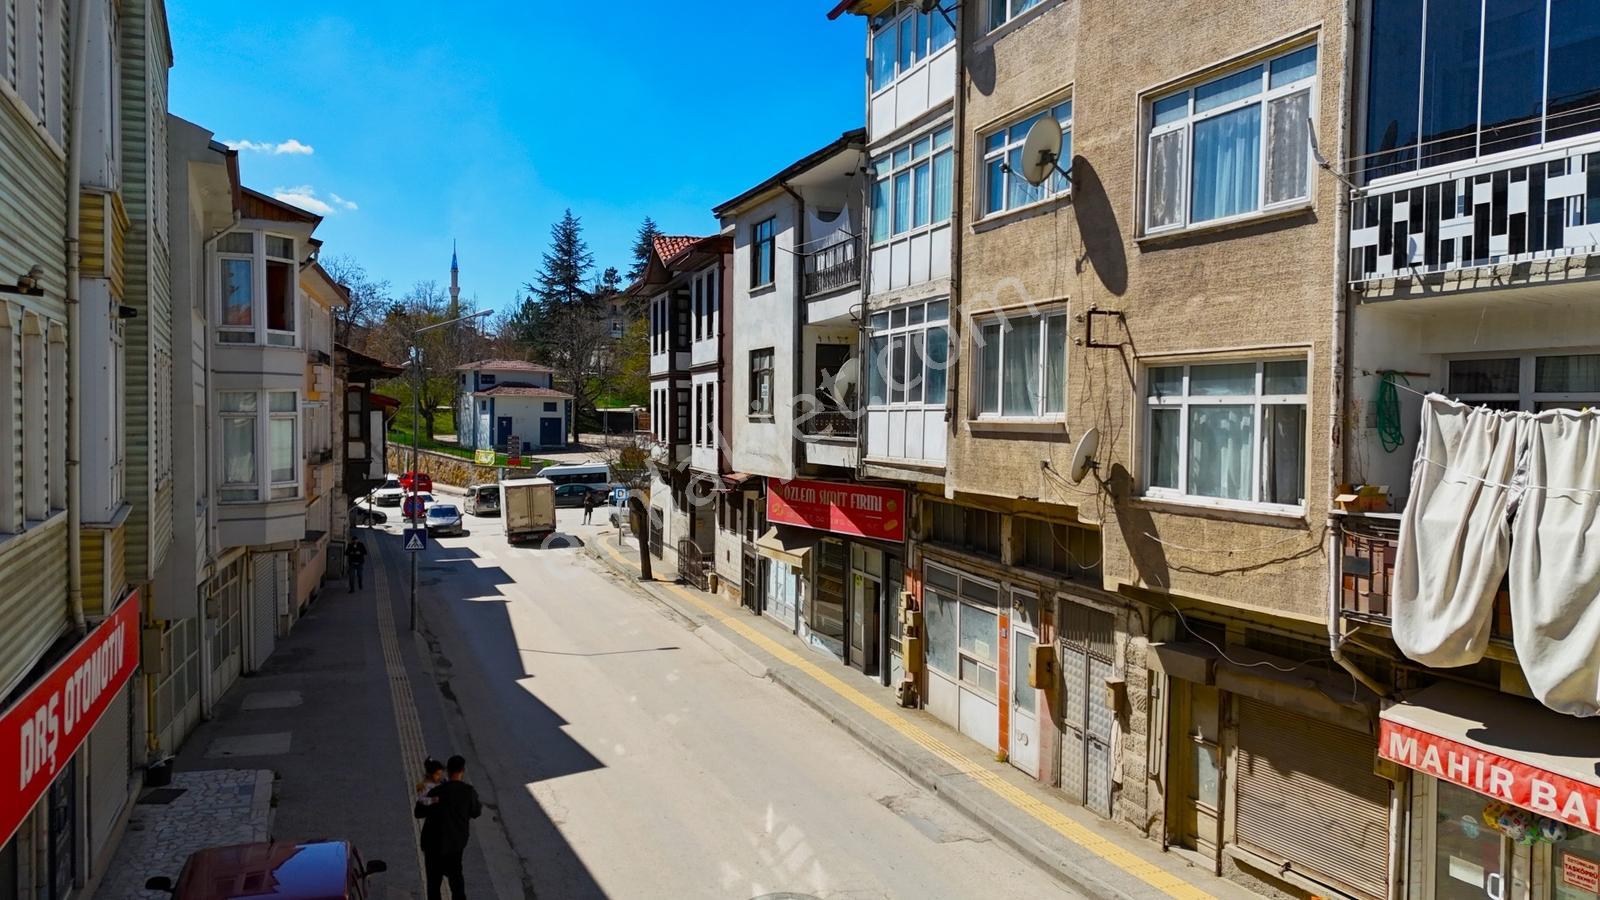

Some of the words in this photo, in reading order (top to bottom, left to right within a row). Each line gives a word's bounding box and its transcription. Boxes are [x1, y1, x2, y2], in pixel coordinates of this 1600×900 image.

[783, 485, 817, 504] ÖZLEM
[20, 690, 60, 792] DRŞ
[63, 614, 125, 736] OTOMOTİV
[1389, 731, 1515, 800] MAHİR
[1531, 778, 1600, 832] BA
